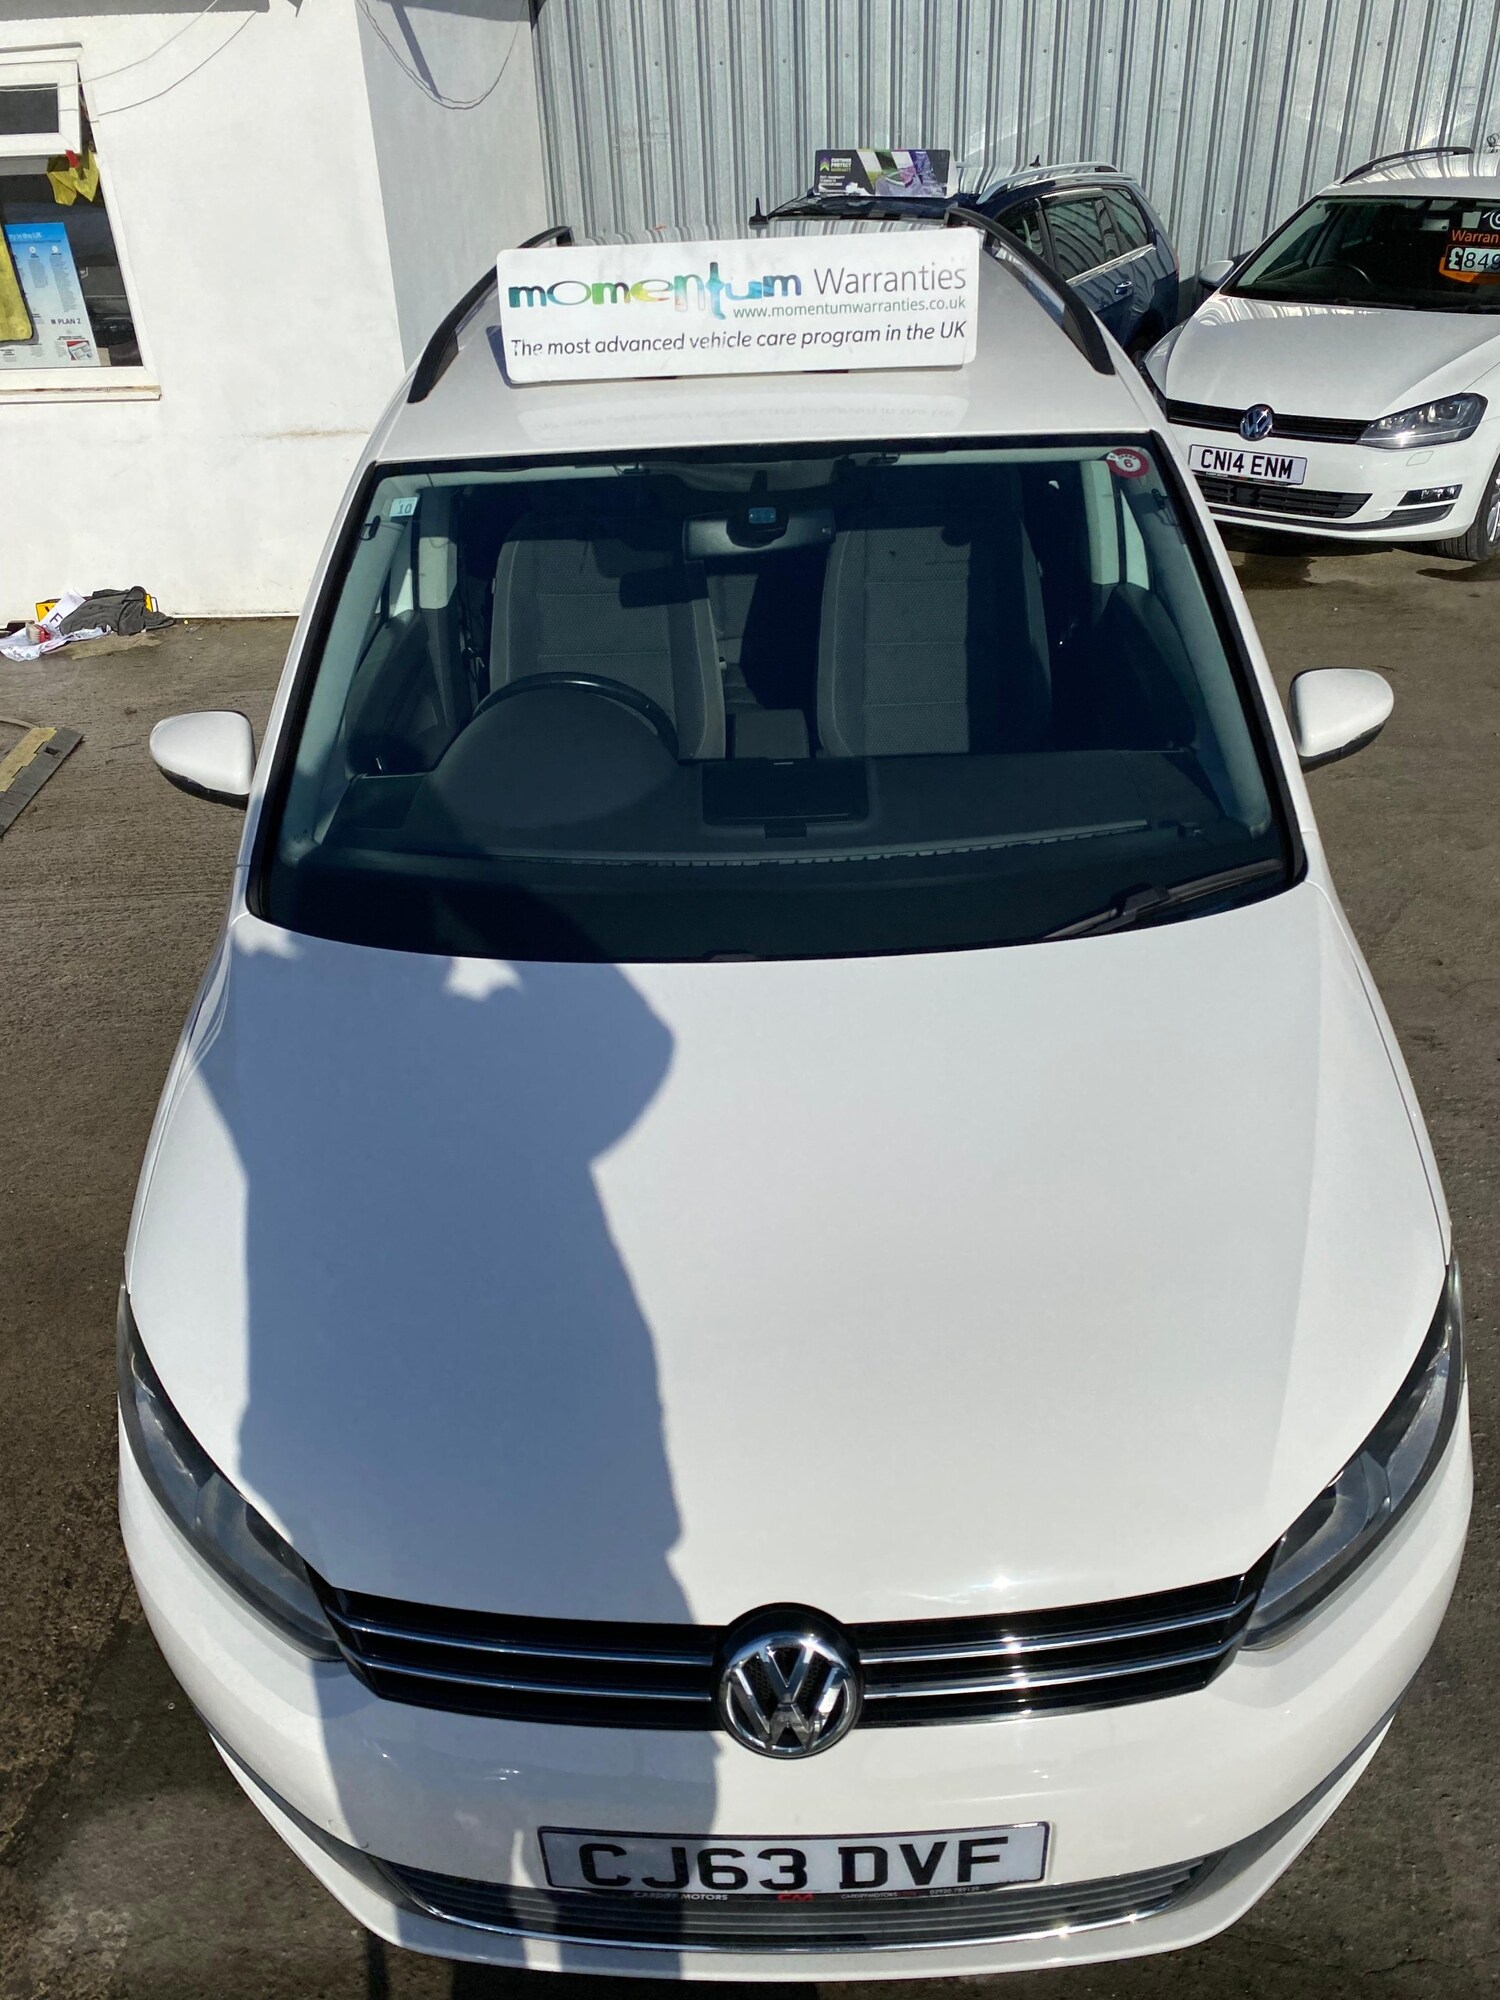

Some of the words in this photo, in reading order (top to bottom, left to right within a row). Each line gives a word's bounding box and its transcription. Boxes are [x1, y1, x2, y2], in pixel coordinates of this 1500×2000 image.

[508, 262, 802, 320] momentum
[813, 262, 967, 295] Warranties
[733, 296, 967, 318] www.momentumwarranties.co.uk
[511, 338, 543, 357] The
[548, 338, 591, 355] most
[595, 332, 686, 354] advanced
[689, 330, 752, 350] vehicle
[756, 332, 796, 347] care
[800, 329, 881, 349] program
[885, 324, 901, 341] in
[906, 323, 935, 341] the
[940, 320, 967, 339] UK
[1200, 448, 1245, 473] CN14
[1250, 454, 1294, 480] ENM
[578, 1841, 808, 1892] CJ63
[837, 1836, 1009, 1890] DVF
[680, 1893, 729, 1901] MOTORS
